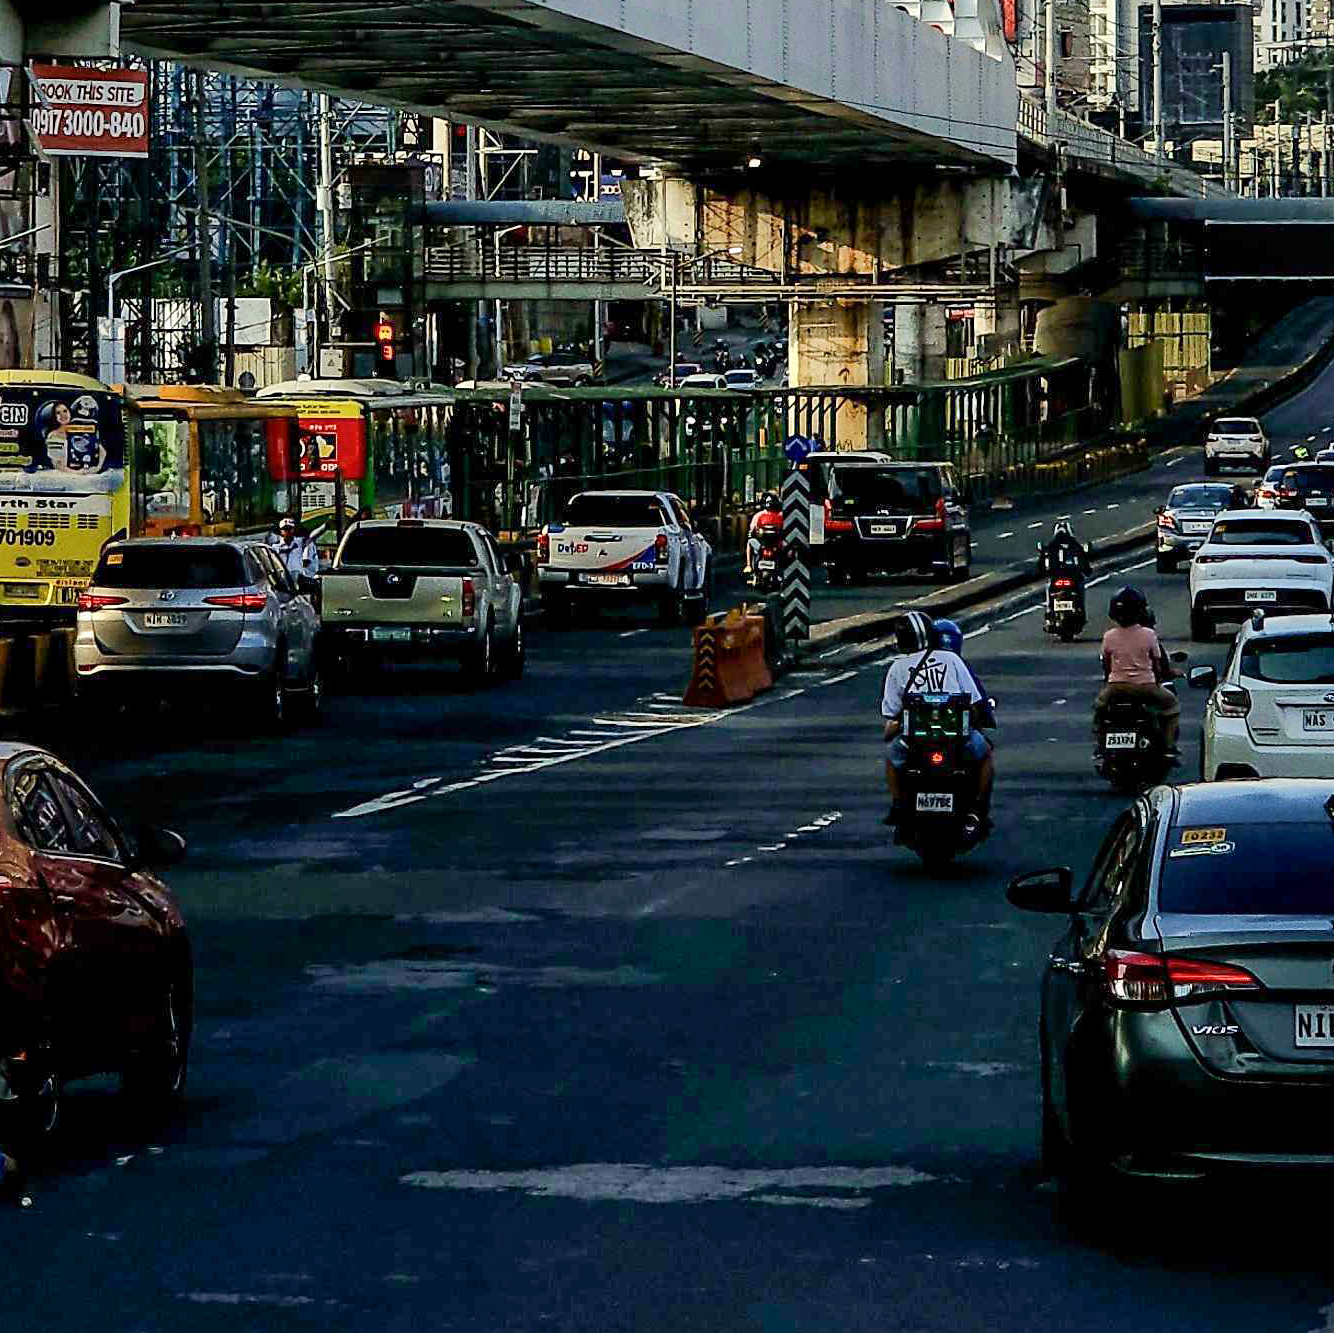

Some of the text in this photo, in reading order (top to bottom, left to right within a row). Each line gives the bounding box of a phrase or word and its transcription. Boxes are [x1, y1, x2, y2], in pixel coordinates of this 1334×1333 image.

[77, 84, 104, 101] THIS
[107, 86, 135, 103] SITE
[35, 499, 78, 510] Star
[1305, 714, 1327, 727] NAS
[1192, 1025, 1239, 1036] VIOS
